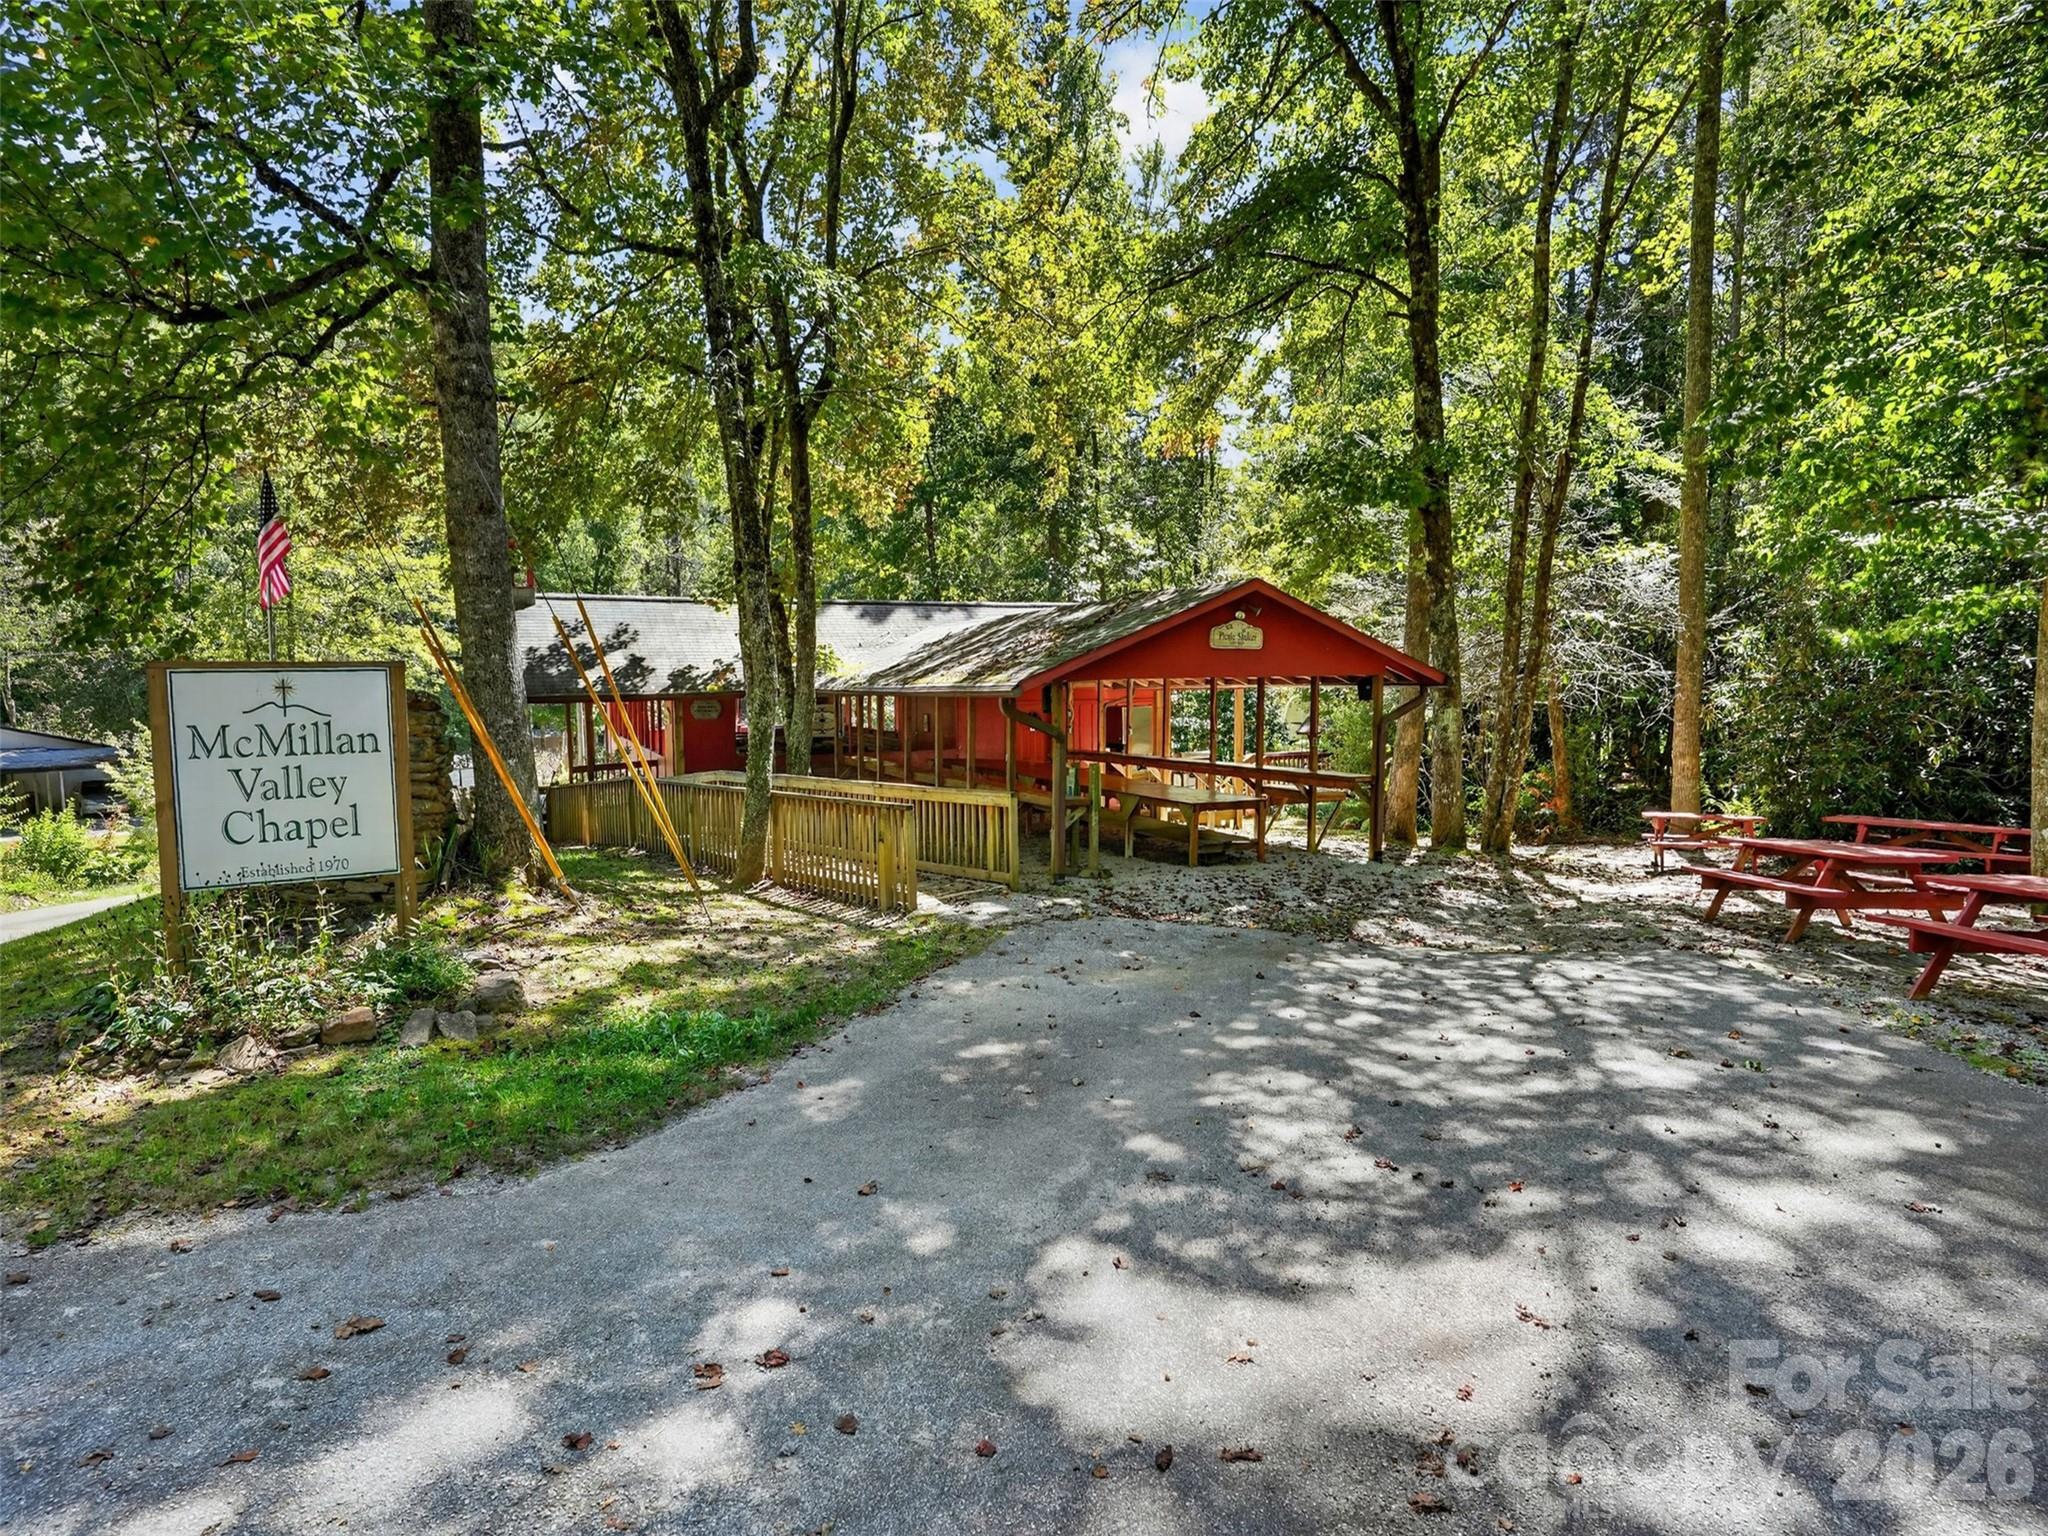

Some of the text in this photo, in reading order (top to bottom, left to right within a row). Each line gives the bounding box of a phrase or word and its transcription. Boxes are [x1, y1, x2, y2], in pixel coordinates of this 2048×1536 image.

[186, 720, 382, 760] McMillan
[227, 764, 348, 805] Valley
[221, 803, 362, 849] Chapel
[240, 857, 350, 879] Established 1970
